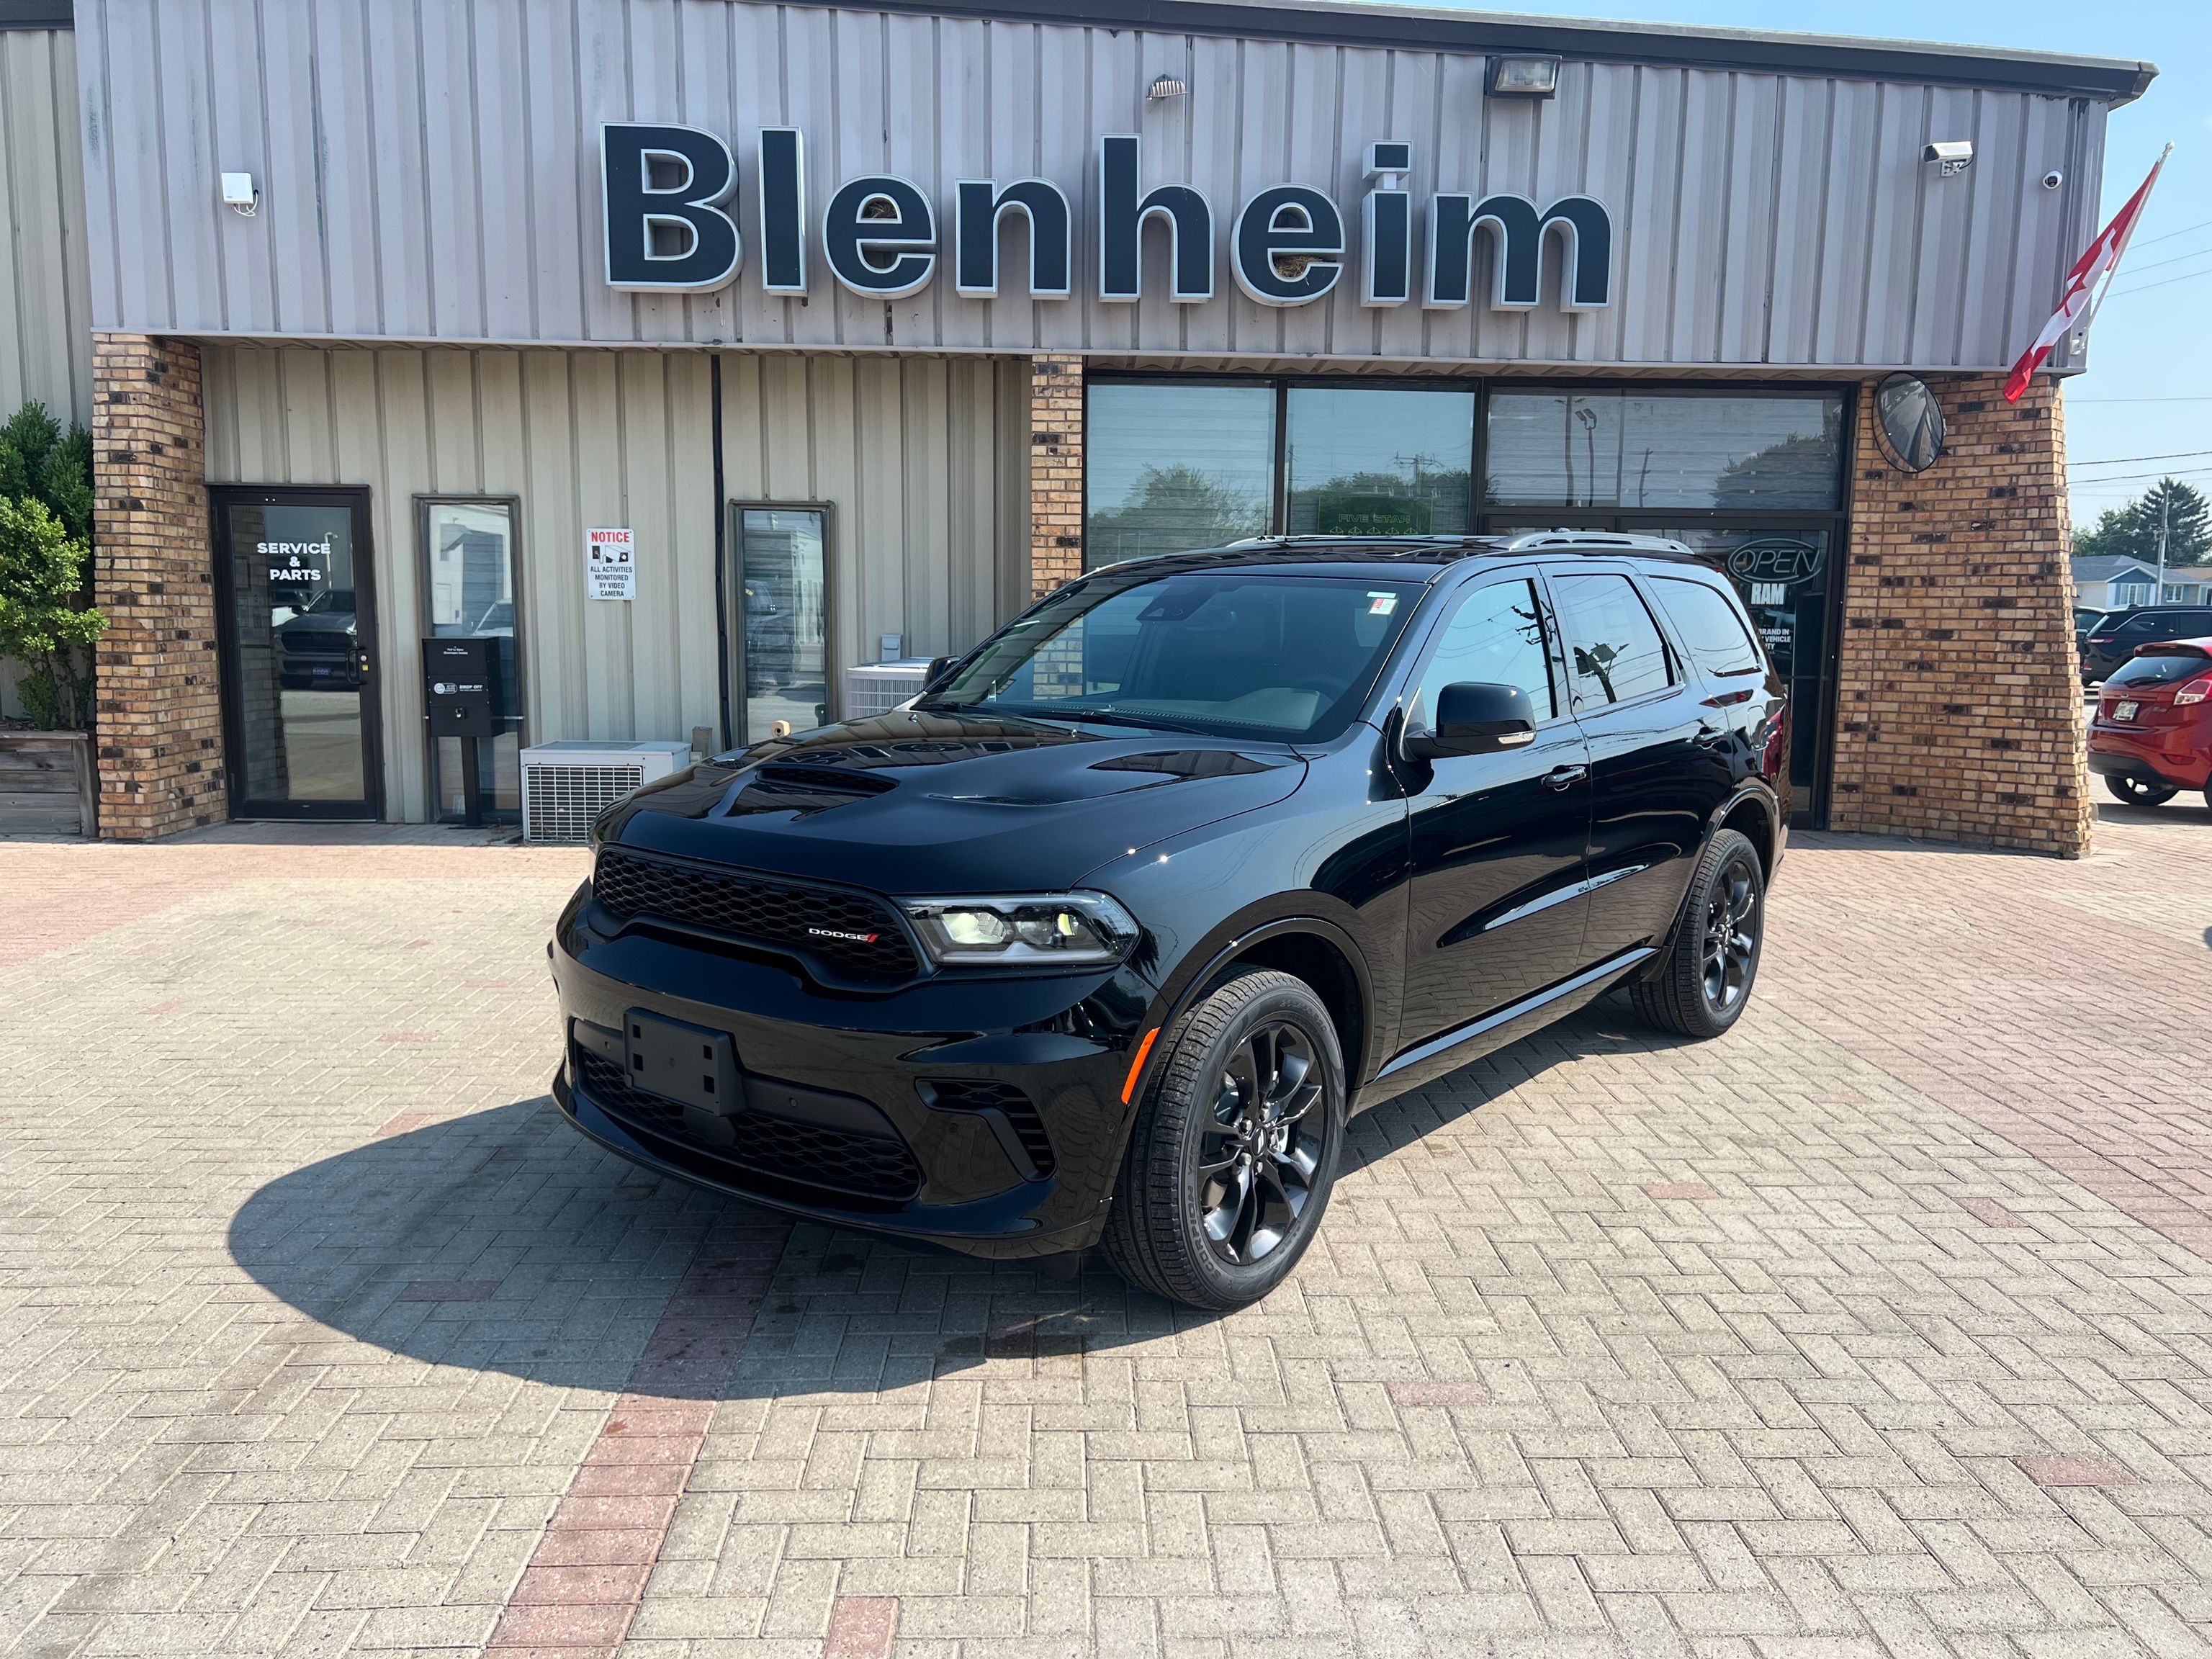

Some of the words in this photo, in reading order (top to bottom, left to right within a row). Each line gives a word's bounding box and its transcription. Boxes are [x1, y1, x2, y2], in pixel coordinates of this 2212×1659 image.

[601, 121, 1614, 313] Blenheim
[1339, 514, 1369, 523] FIVE
[1373, 514, 1411, 523] STAR
[591, 531, 630, 543] NOTICE
[257, 542, 331, 554] SERVICE
[289, 556, 300, 567] &
[1733, 549, 1820, 573] OPEN
[269, 569, 321, 580] PARTS
[1751, 583, 1785, 605] RAM
[809, 928, 868, 941] DODGE
[1187, 1185, 1222, 1280] SCORPION
